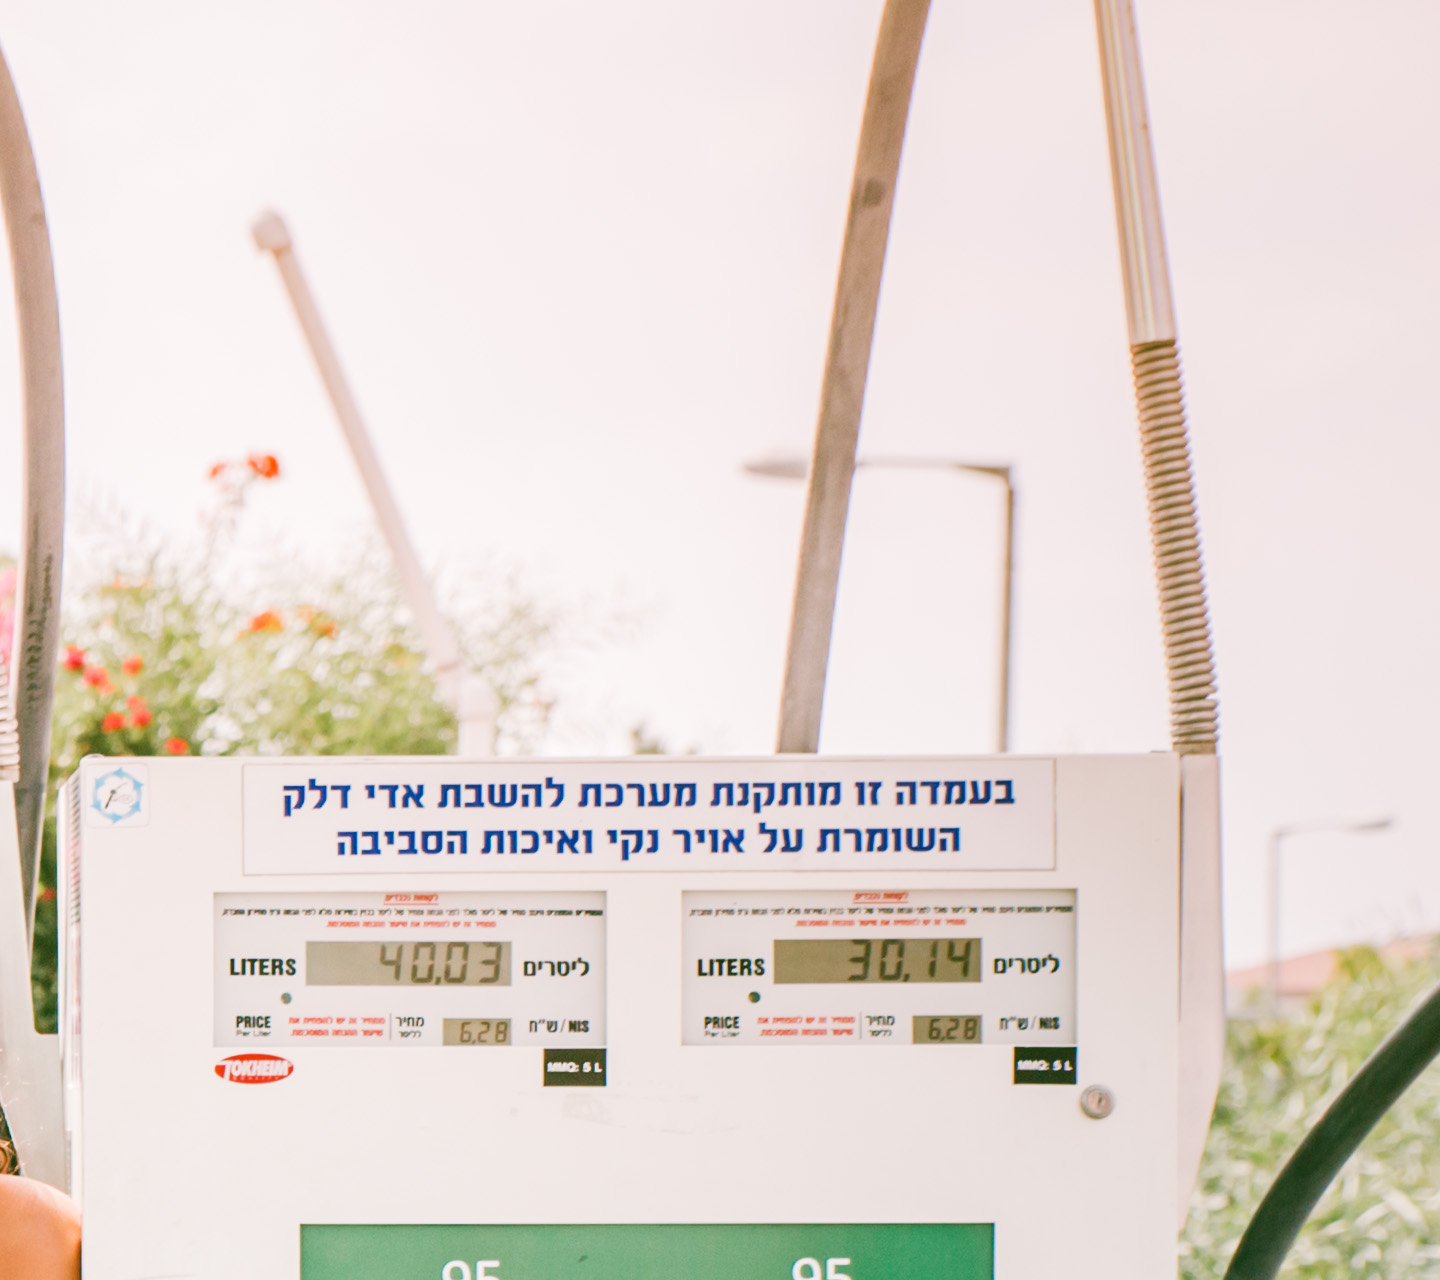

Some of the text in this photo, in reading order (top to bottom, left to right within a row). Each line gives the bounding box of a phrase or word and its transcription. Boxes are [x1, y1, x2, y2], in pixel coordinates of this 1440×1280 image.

[284, 777, 1015, 816] בעמדה זו מותקנת מערכת להשבת אדי דלק
[338, 823, 960, 860] השומרת על אויר נקי ואיכות הסביבה
[230, 959, 296, 975] LITERS
[381, 942, 502, 984] 40,03
[523, 958, 589, 976] ליטרים
[697, 959, 765, 976] LITERS
[848, 940, 971, 982] 30,14
[993, 955, 1060, 974] ליטרים
[236, 1016, 270, 1028] PRICE
[397, 1017, 424, 1027] מחיר
[569, 1021, 589, 1032] NIS
[704, 1016, 739, 1029] PRICE
[866, 1016, 895, 1025] מחיר
[459, 1021, 509, 1045] 6,28
[928, 1018, 978, 1042] 6,28
[215, 1058, 291, 1081] TOKHEIM
[583, 1062, 591, 1072] 5
[594, 1063, 602, 1072] L
[1064, 1061, 1072, 1071] L
